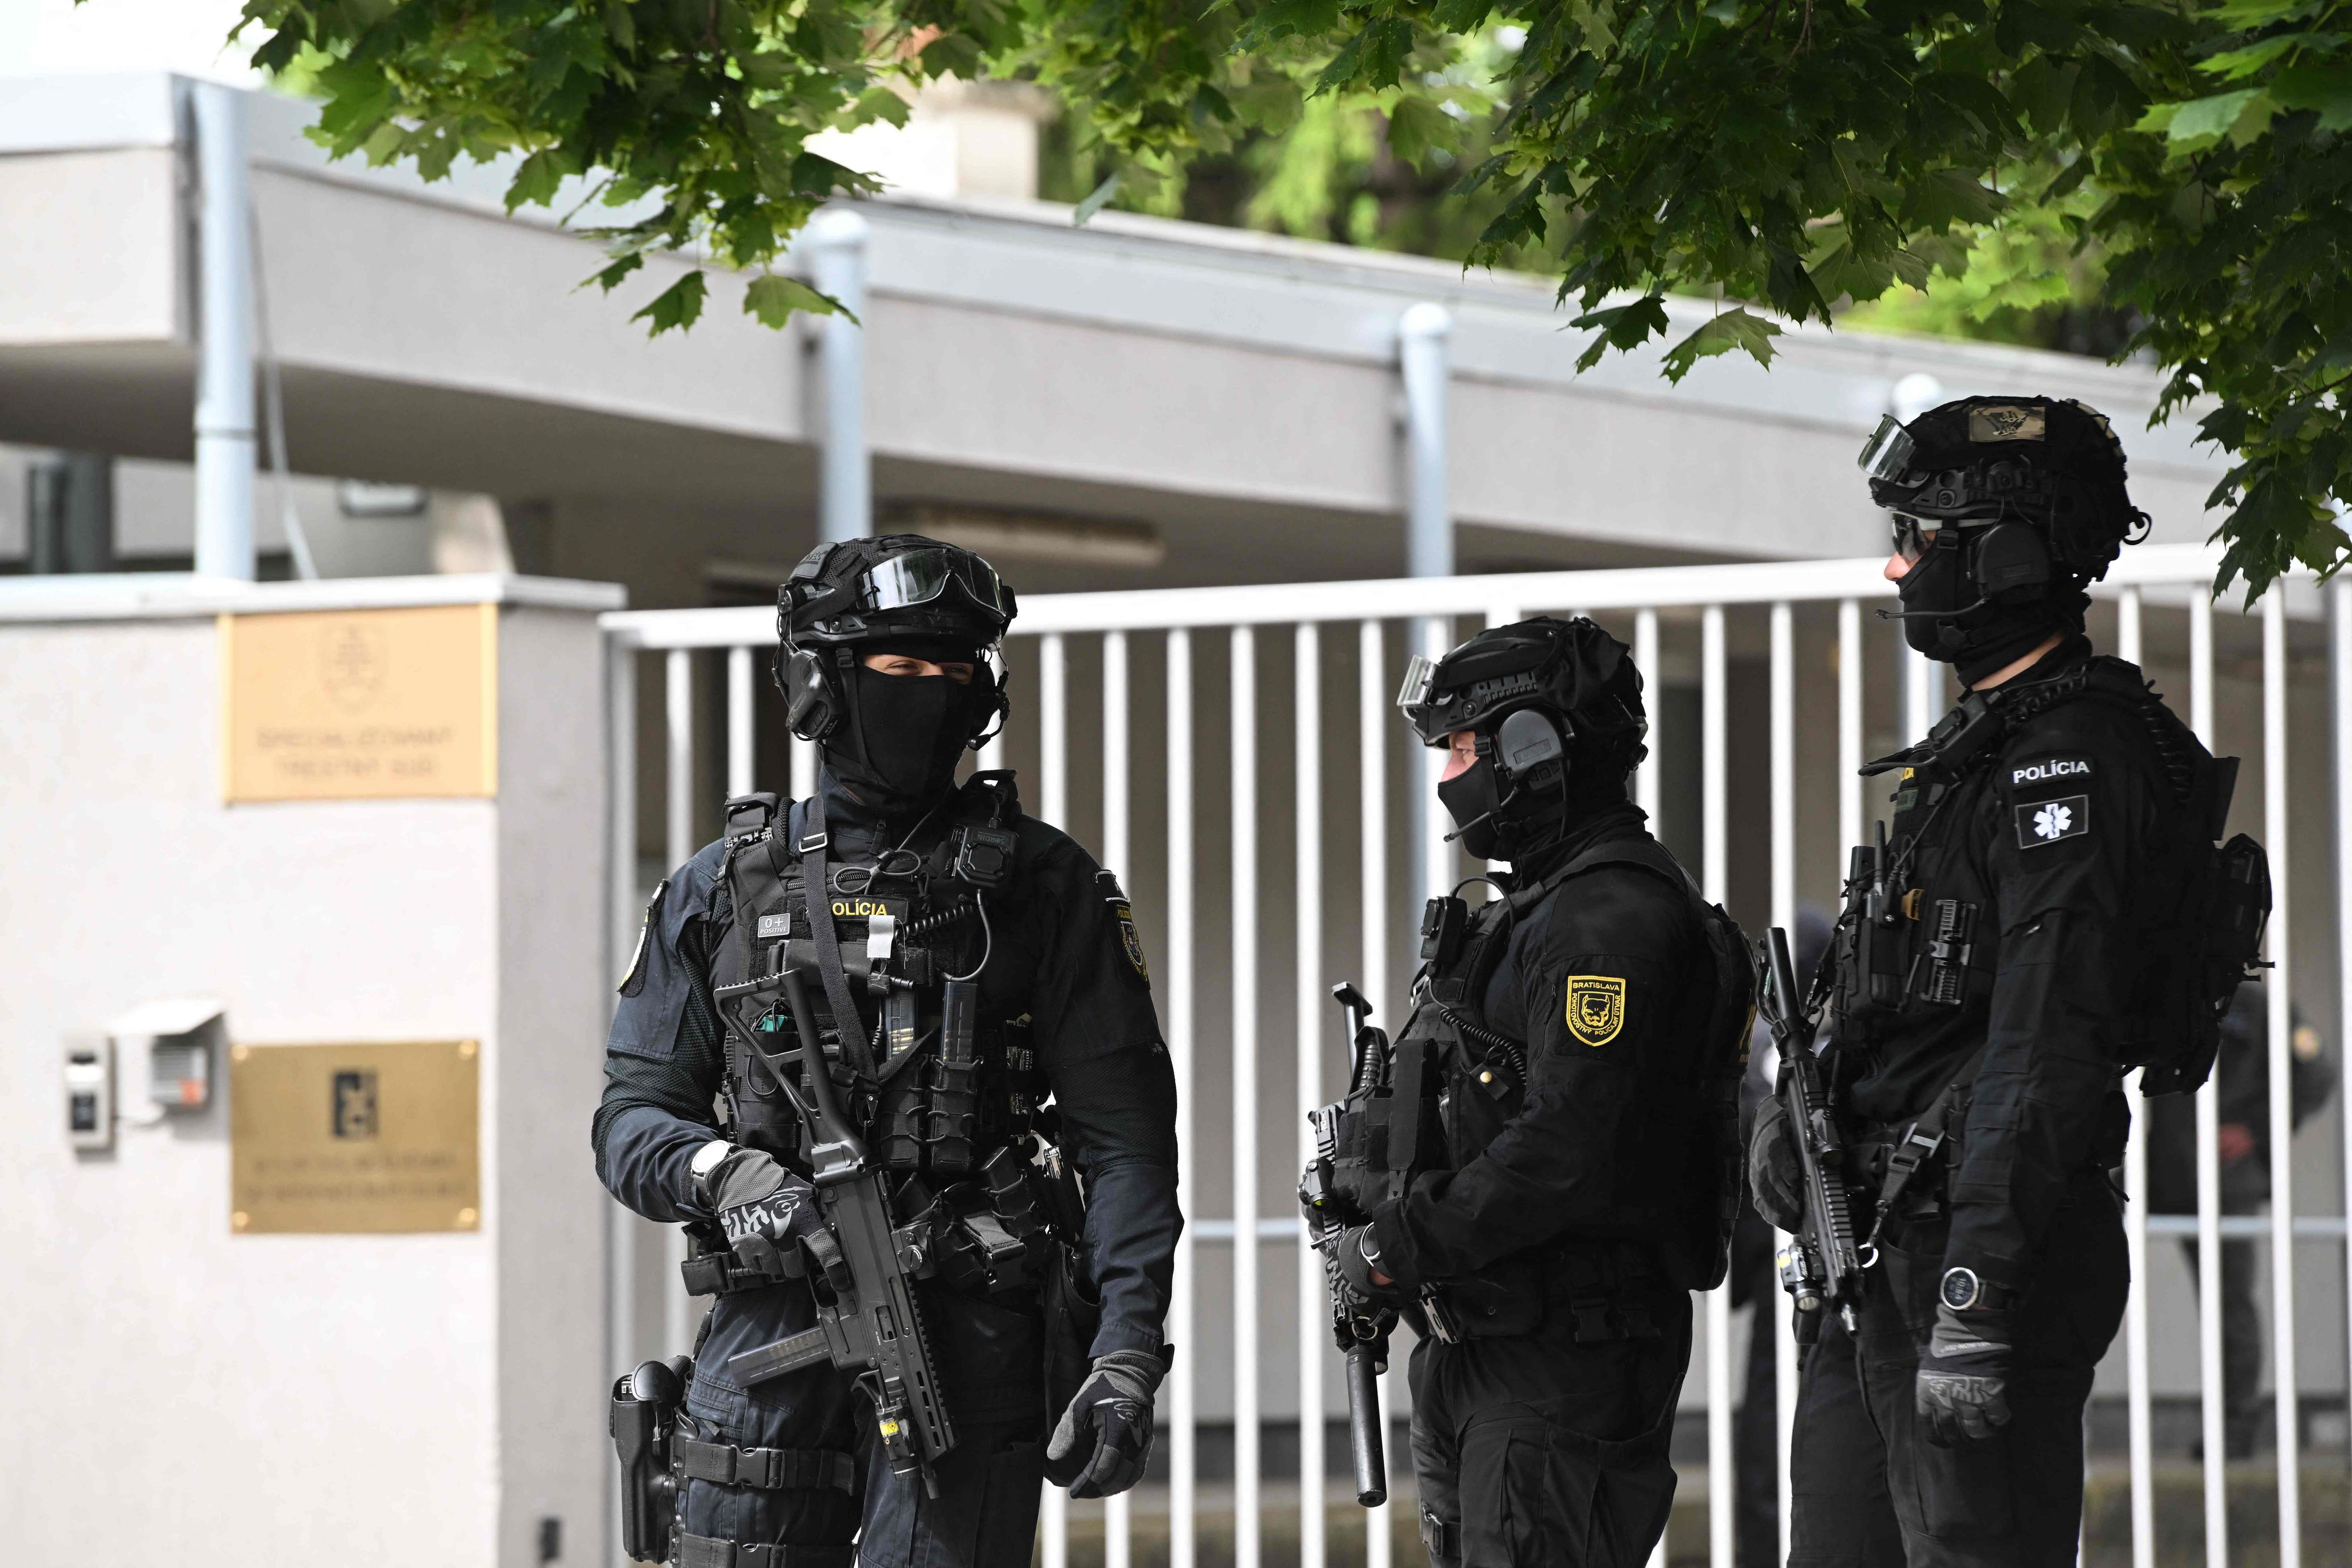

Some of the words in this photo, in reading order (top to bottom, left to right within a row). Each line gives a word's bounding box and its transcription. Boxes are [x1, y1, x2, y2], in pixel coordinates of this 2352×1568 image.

[2013, 760, 2090, 783] POLÍCIA
[977, 834, 1005, 844] SORDIN
[830, 898, 888, 916] OLÍCIA
[1573, 982, 1620, 991] BRATISLAVA
[1112, 1357, 1158, 1373] HELIKON-TEX
